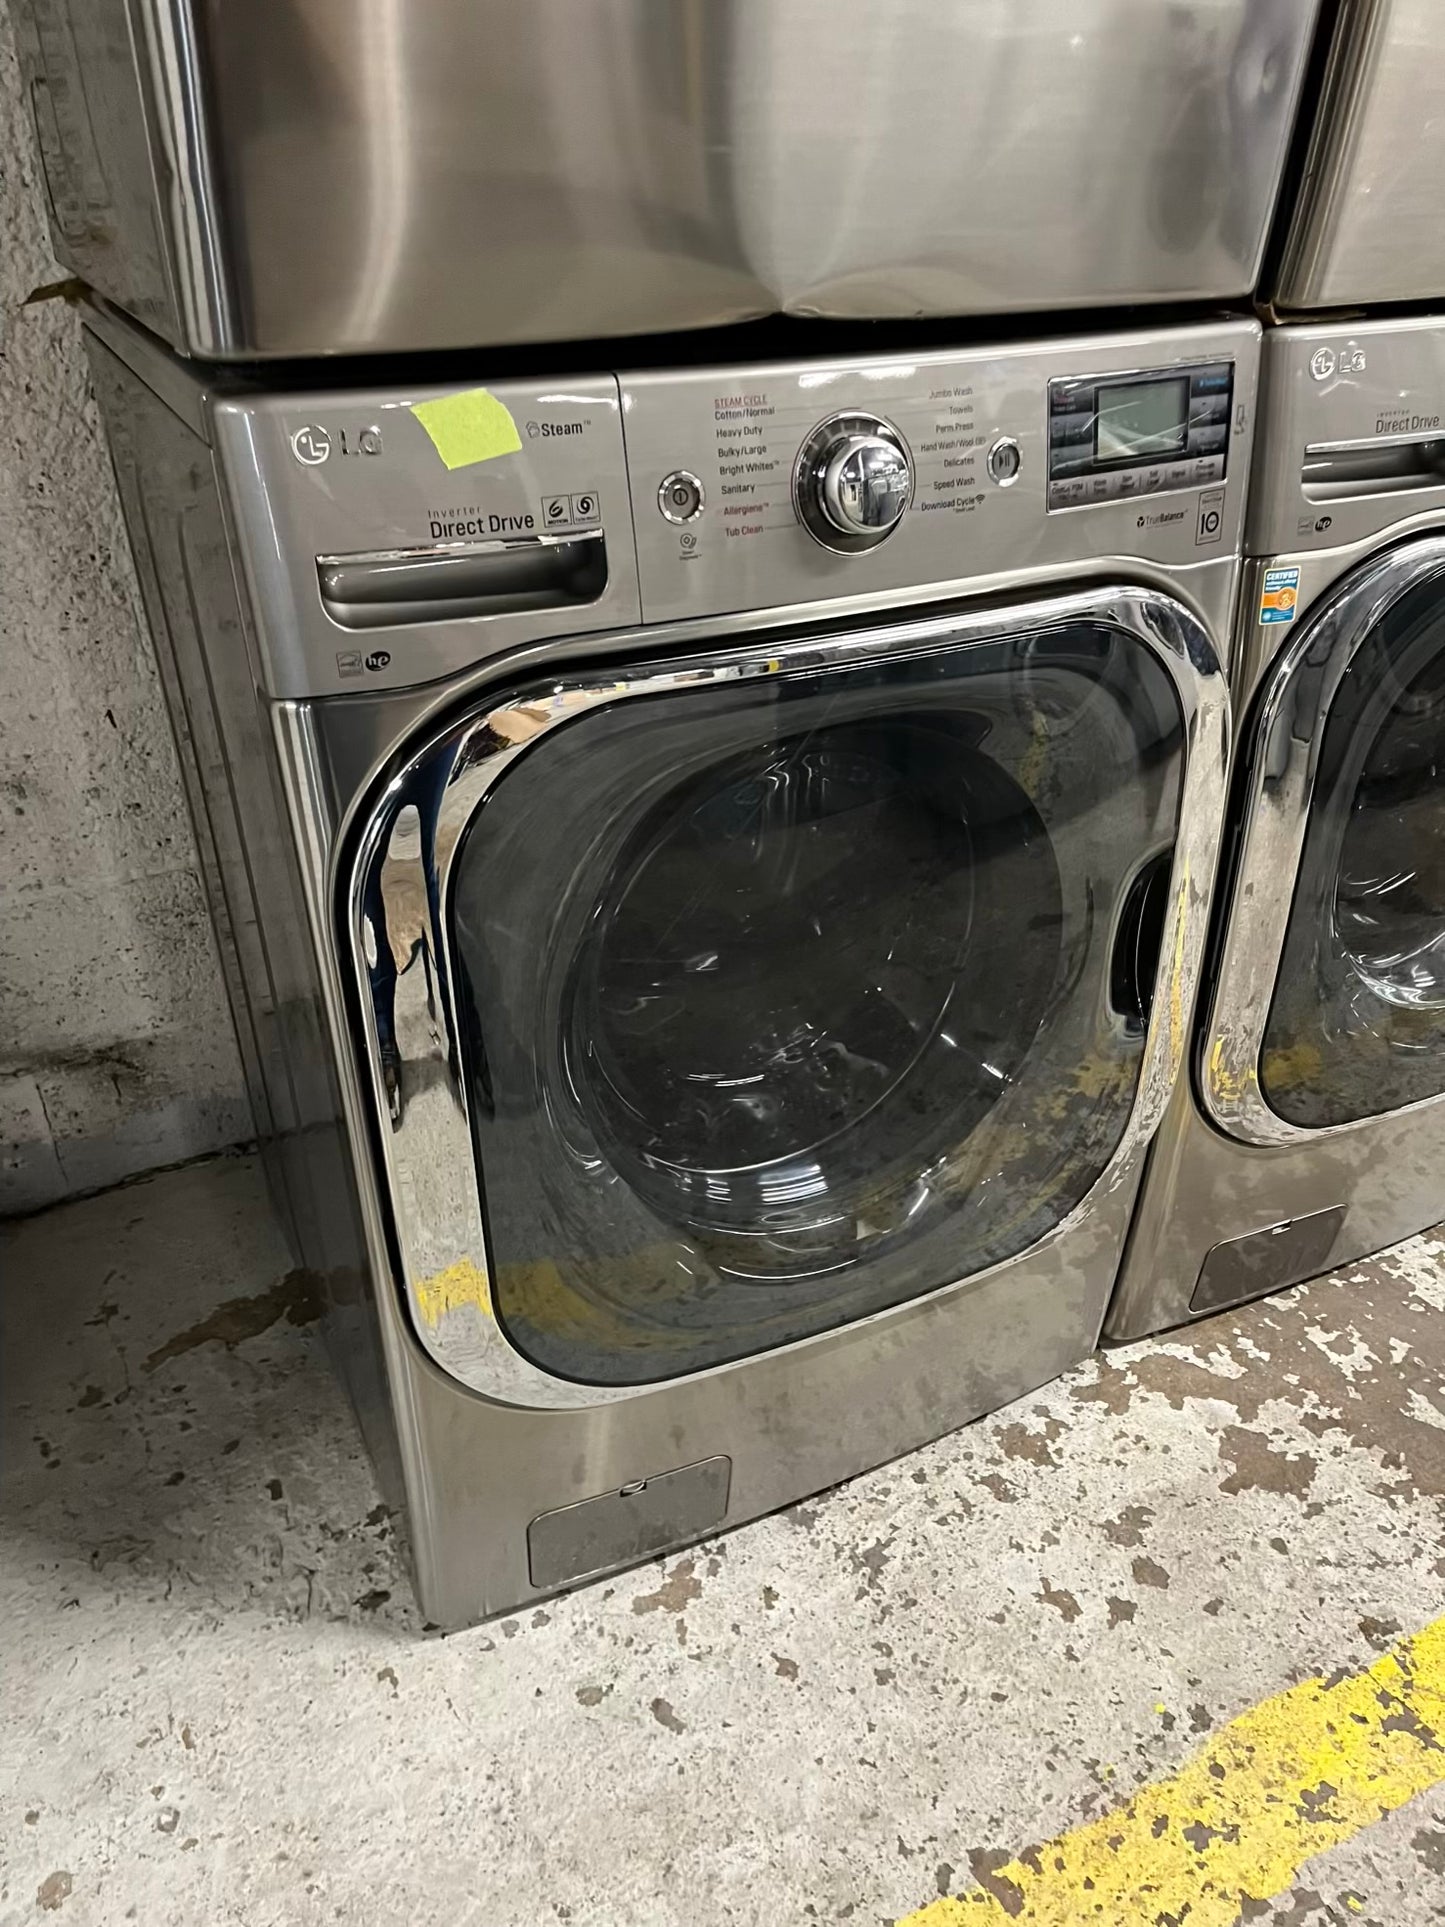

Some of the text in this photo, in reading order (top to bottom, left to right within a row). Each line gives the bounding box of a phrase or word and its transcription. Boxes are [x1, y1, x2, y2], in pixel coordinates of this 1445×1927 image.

[1339, 349, 1366, 374] LG
[953, 387, 973, 397] Wash
[714, 406, 776, 421] Cotton/Normal
[949, 404, 973, 415] Towels
[936, 422, 974, 434] Perm Press
[1376, 415, 1440, 434] Direct Drive
[716, 426, 763, 438] Heavy Duty
[718, 445, 767, 458] Bulky/Large
[920, 442, 938, 452] Hand
[944, 457, 975, 468] Delicates
[719, 464, 744, 476] Bright
[721, 484, 756, 495] Sanitary
[933, 477, 975, 491] Speed Wash
[921, 499, 955, 512] Download
[956, 496, 975, 507] Cycle
[427, 506, 481, 518] Inverter
[430, 514, 535, 539] Direct Drive
[1200, 510, 1220, 536] 10
[725, 525, 764, 537] Tub Clean
